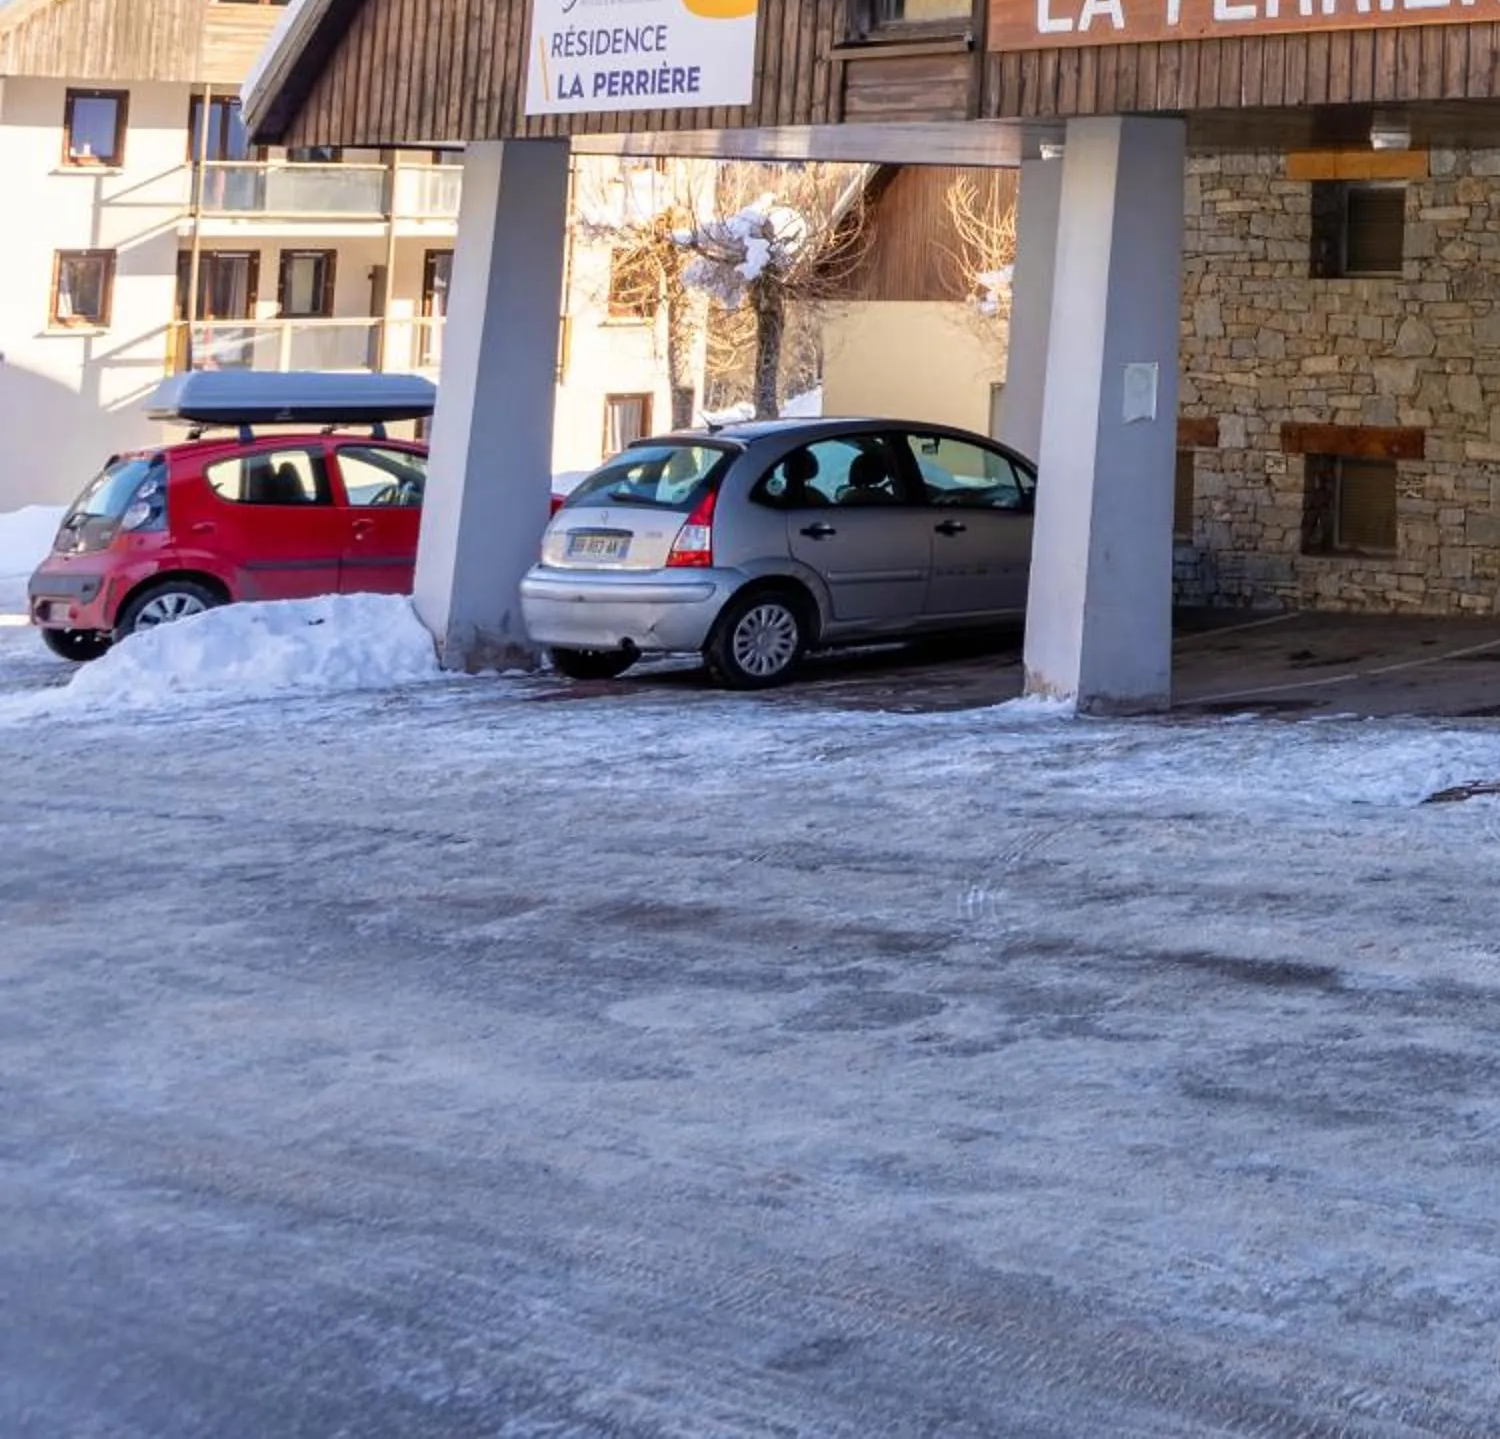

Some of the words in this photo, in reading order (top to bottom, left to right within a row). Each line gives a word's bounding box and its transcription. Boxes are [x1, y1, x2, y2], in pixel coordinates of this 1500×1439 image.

[551, 24, 668, 59] RÉSIDENCE
[557, 73, 585, 100] LA
[592, 60, 702, 99] PERRIÈRE
